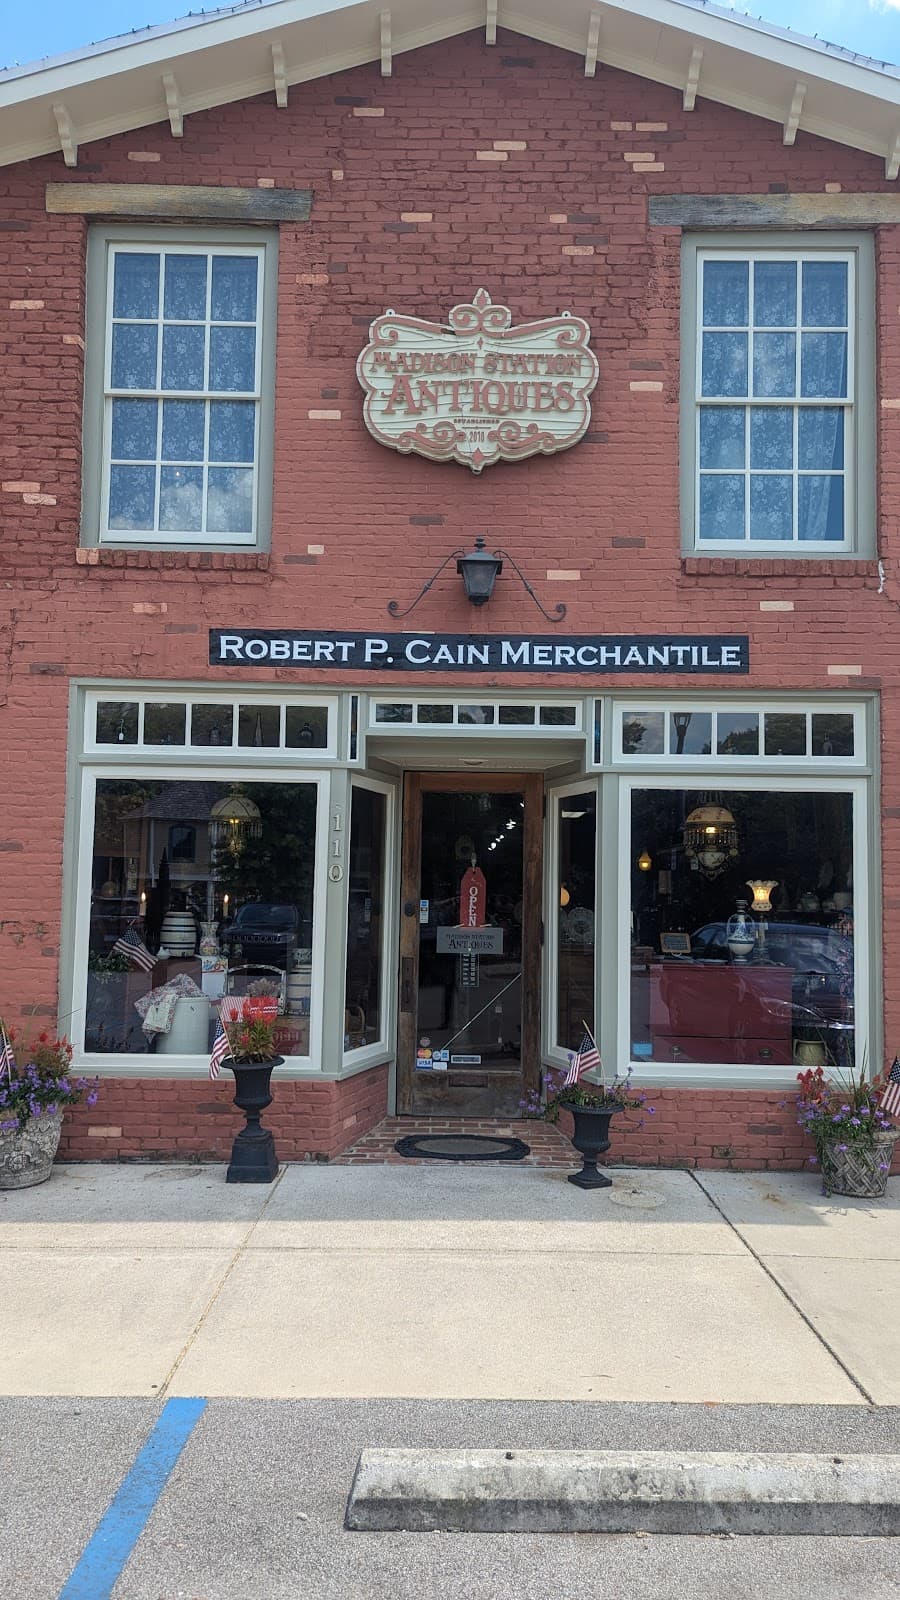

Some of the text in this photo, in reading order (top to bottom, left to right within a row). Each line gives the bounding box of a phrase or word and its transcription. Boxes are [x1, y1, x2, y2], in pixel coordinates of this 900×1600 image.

[369, 352, 583, 375] MADISON STATION
[381, 375, 575, 415] ANTIQUES
[469, 431, 485, 443] 2010
[219, 635, 741, 668] ROBERT P. CAIN MERCHANTILE
[329, 814, 343, 882] 110
[468, 886, 478, 927] OPEN
[448, 939, 494, 949] ANTIQUES
